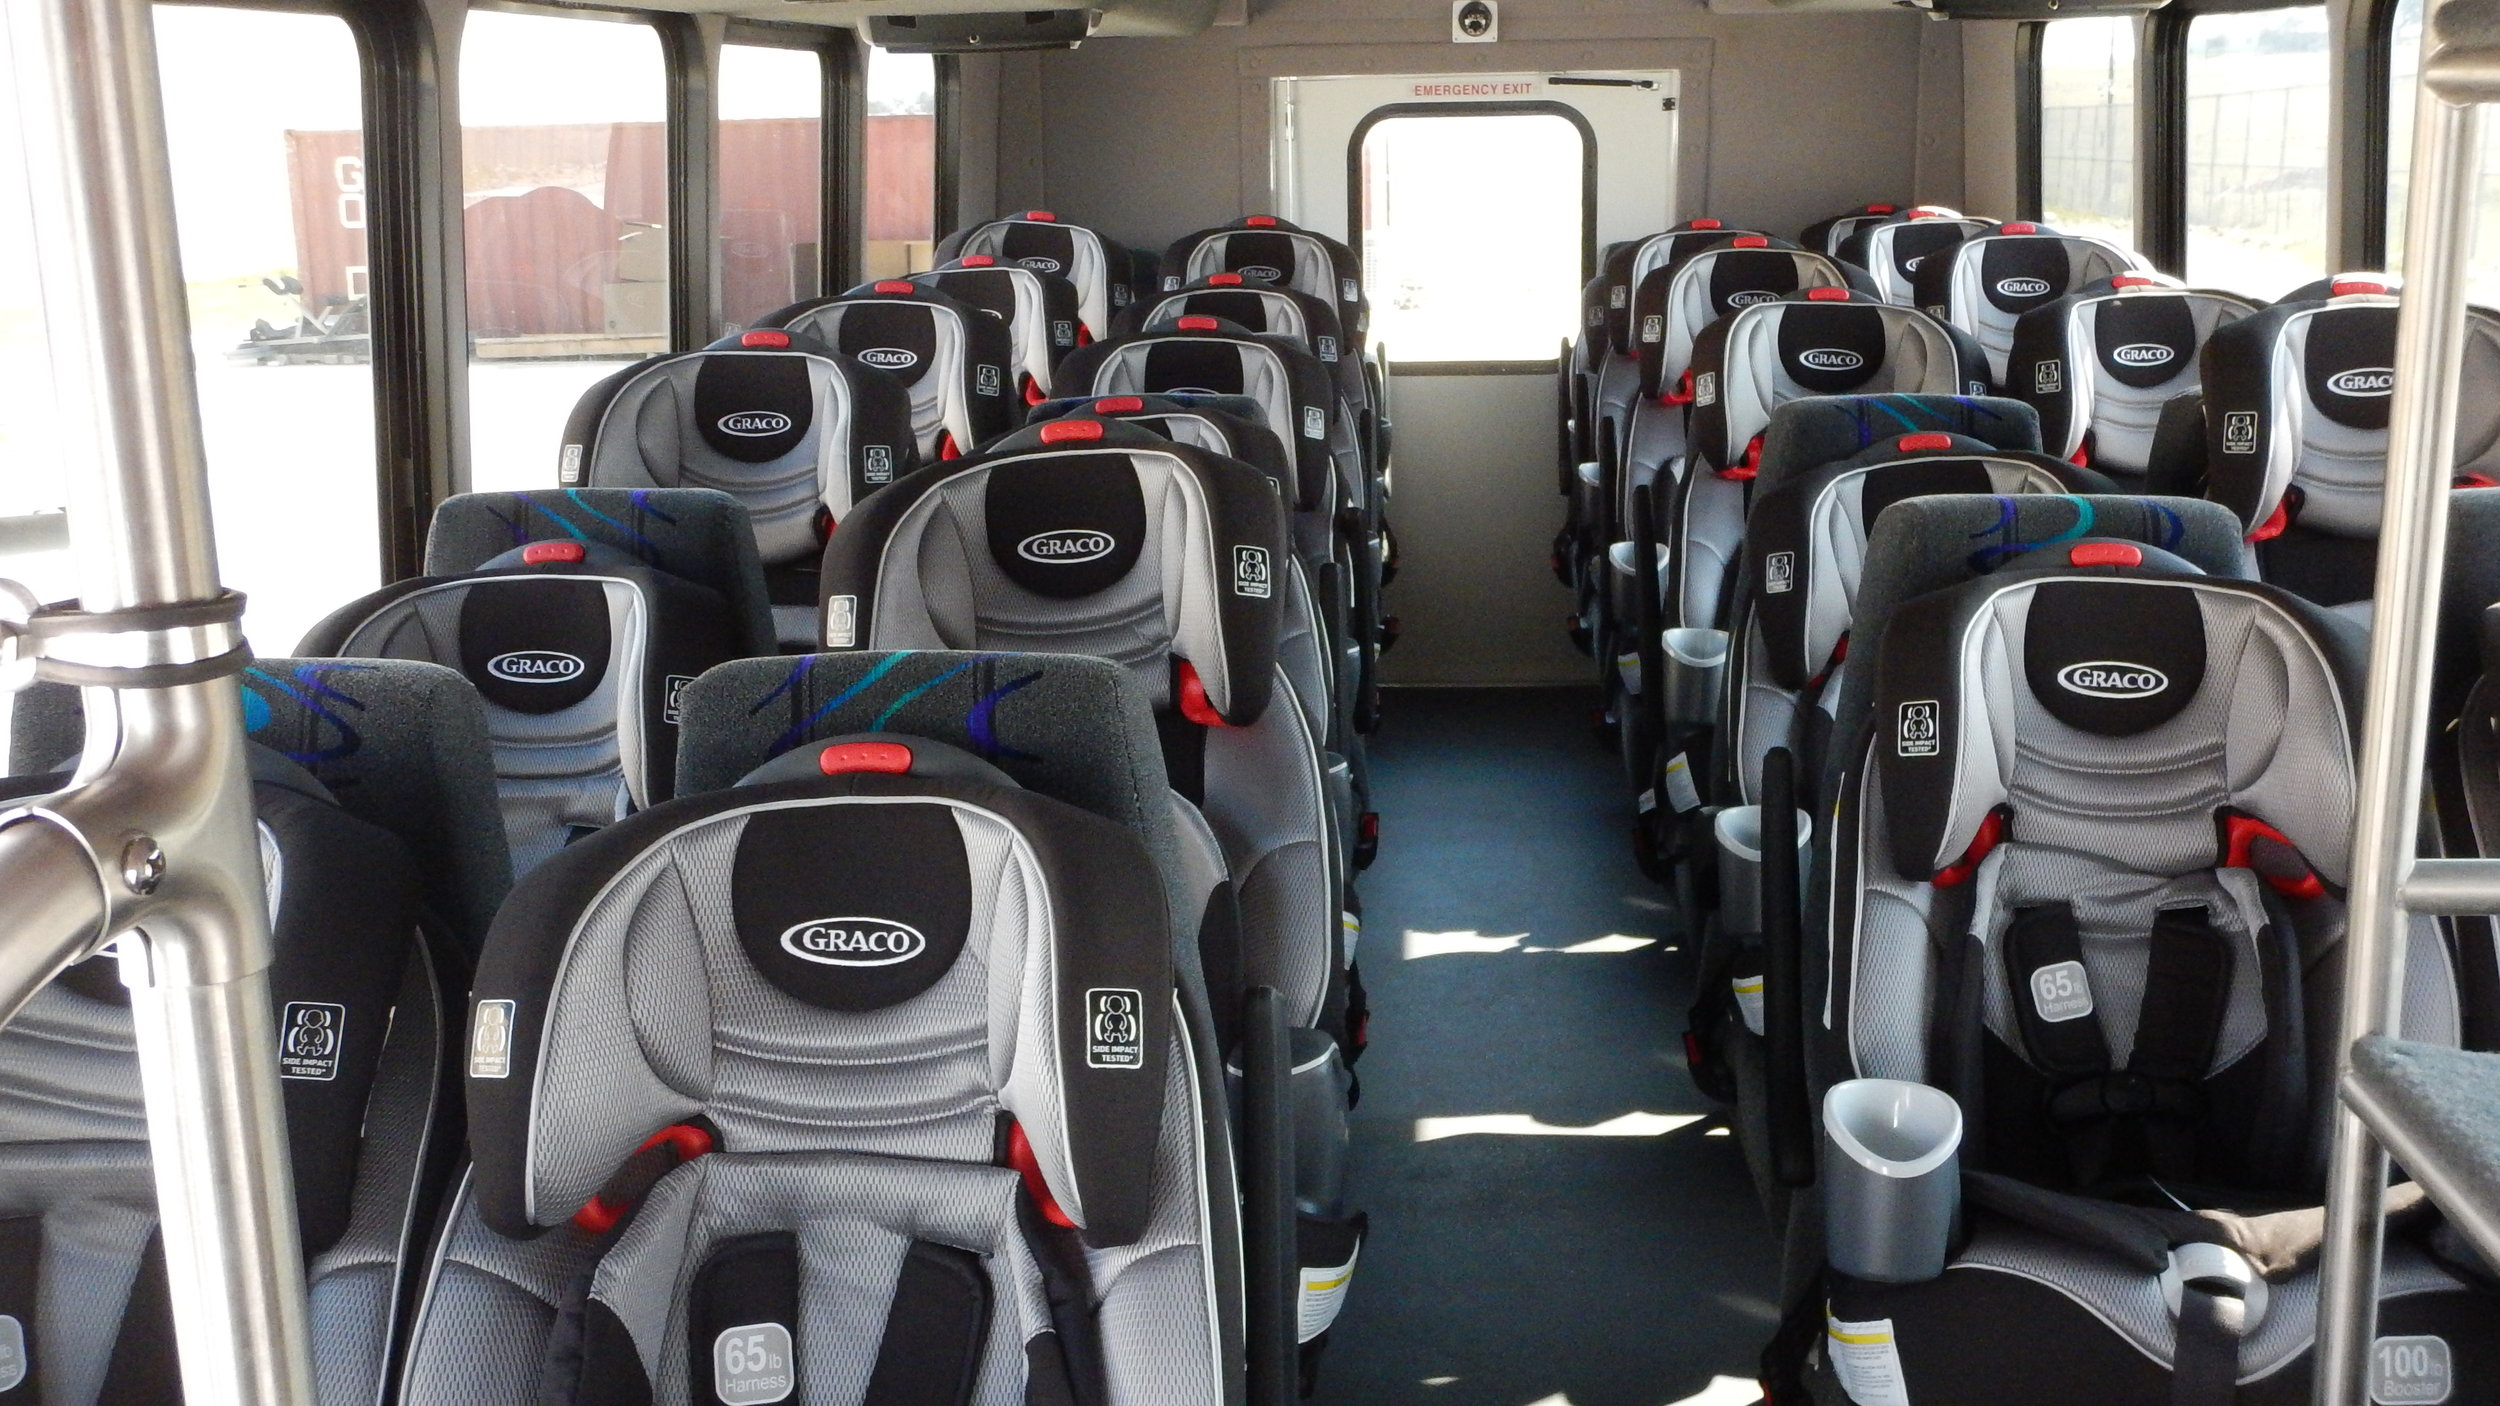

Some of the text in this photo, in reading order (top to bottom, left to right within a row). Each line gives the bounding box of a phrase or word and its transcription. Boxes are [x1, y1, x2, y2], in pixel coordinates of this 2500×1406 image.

[1414, 83, 1532, 96] EMERGENCY EXIT
[1021, 259, 1056, 270] GRACO
[2003, 281, 2045, 292] GRACO
[866, 351, 912, 363] GRACO
[1808, 352, 1857, 365] GRACO
[2120, 348, 2167, 360] GRACO
[728, 416, 784, 430] GRACO
[1031, 536, 1105, 556] GRACO
[502, 657, 575, 674] GRACO
[2073, 668, 2156, 690] GRACO
[802, 926, 910, 953] GRACO
[1092, 1045, 1139, 1053] SIDE IMPACT
[282, 1057, 333, 1067] SIDE IMPACT
[725, 1375, 787, 1394] Harness
